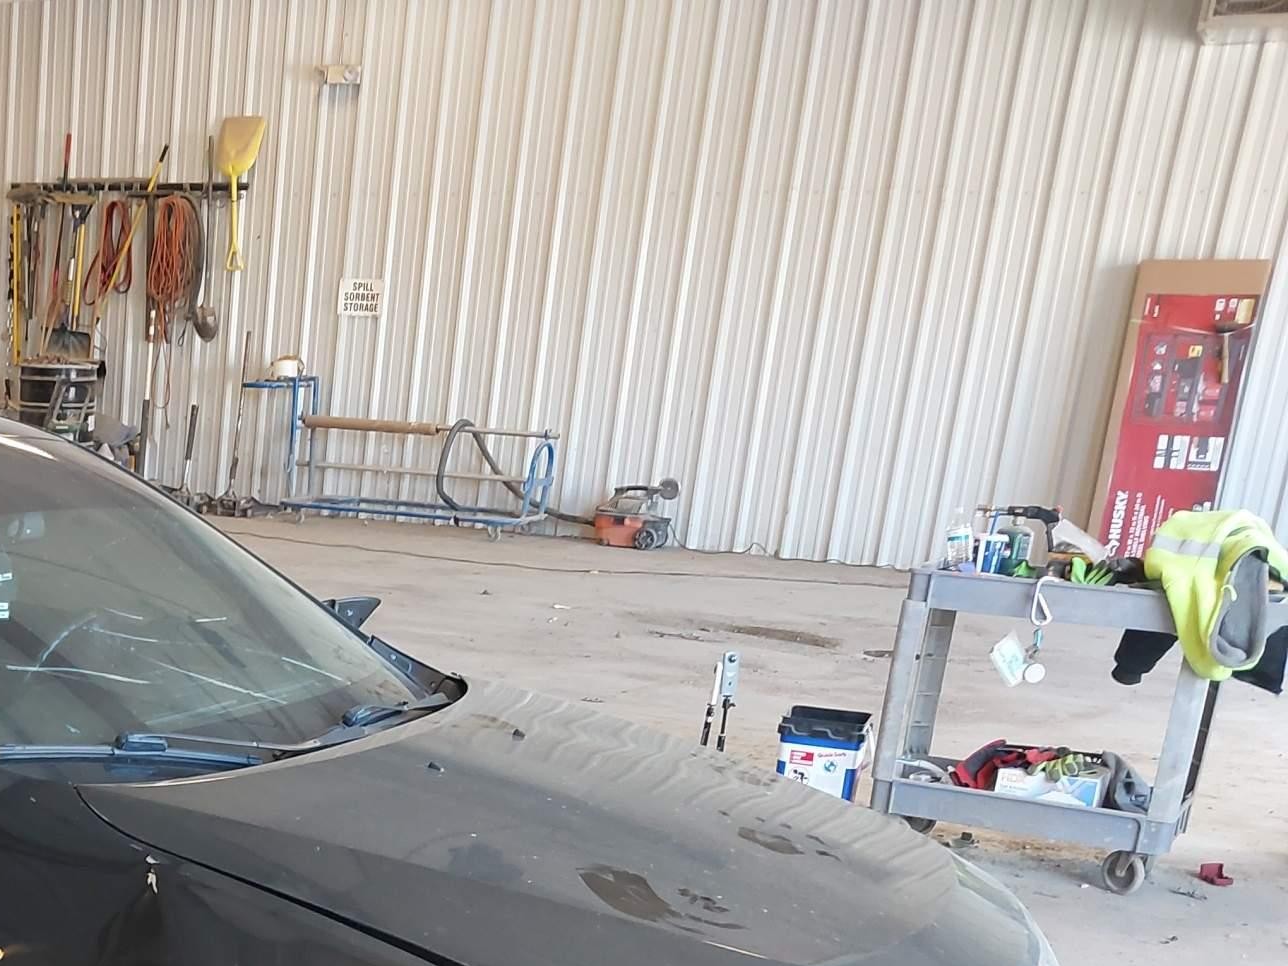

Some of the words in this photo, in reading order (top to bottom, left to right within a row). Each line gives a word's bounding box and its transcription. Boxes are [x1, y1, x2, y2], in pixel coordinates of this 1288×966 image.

[353, 281, 374, 292] SPILL
[344, 292, 380, 302] SORBENT
[343, 302, 378, 312] STORAGE
[1108, 490, 1129, 540] HUSKY
